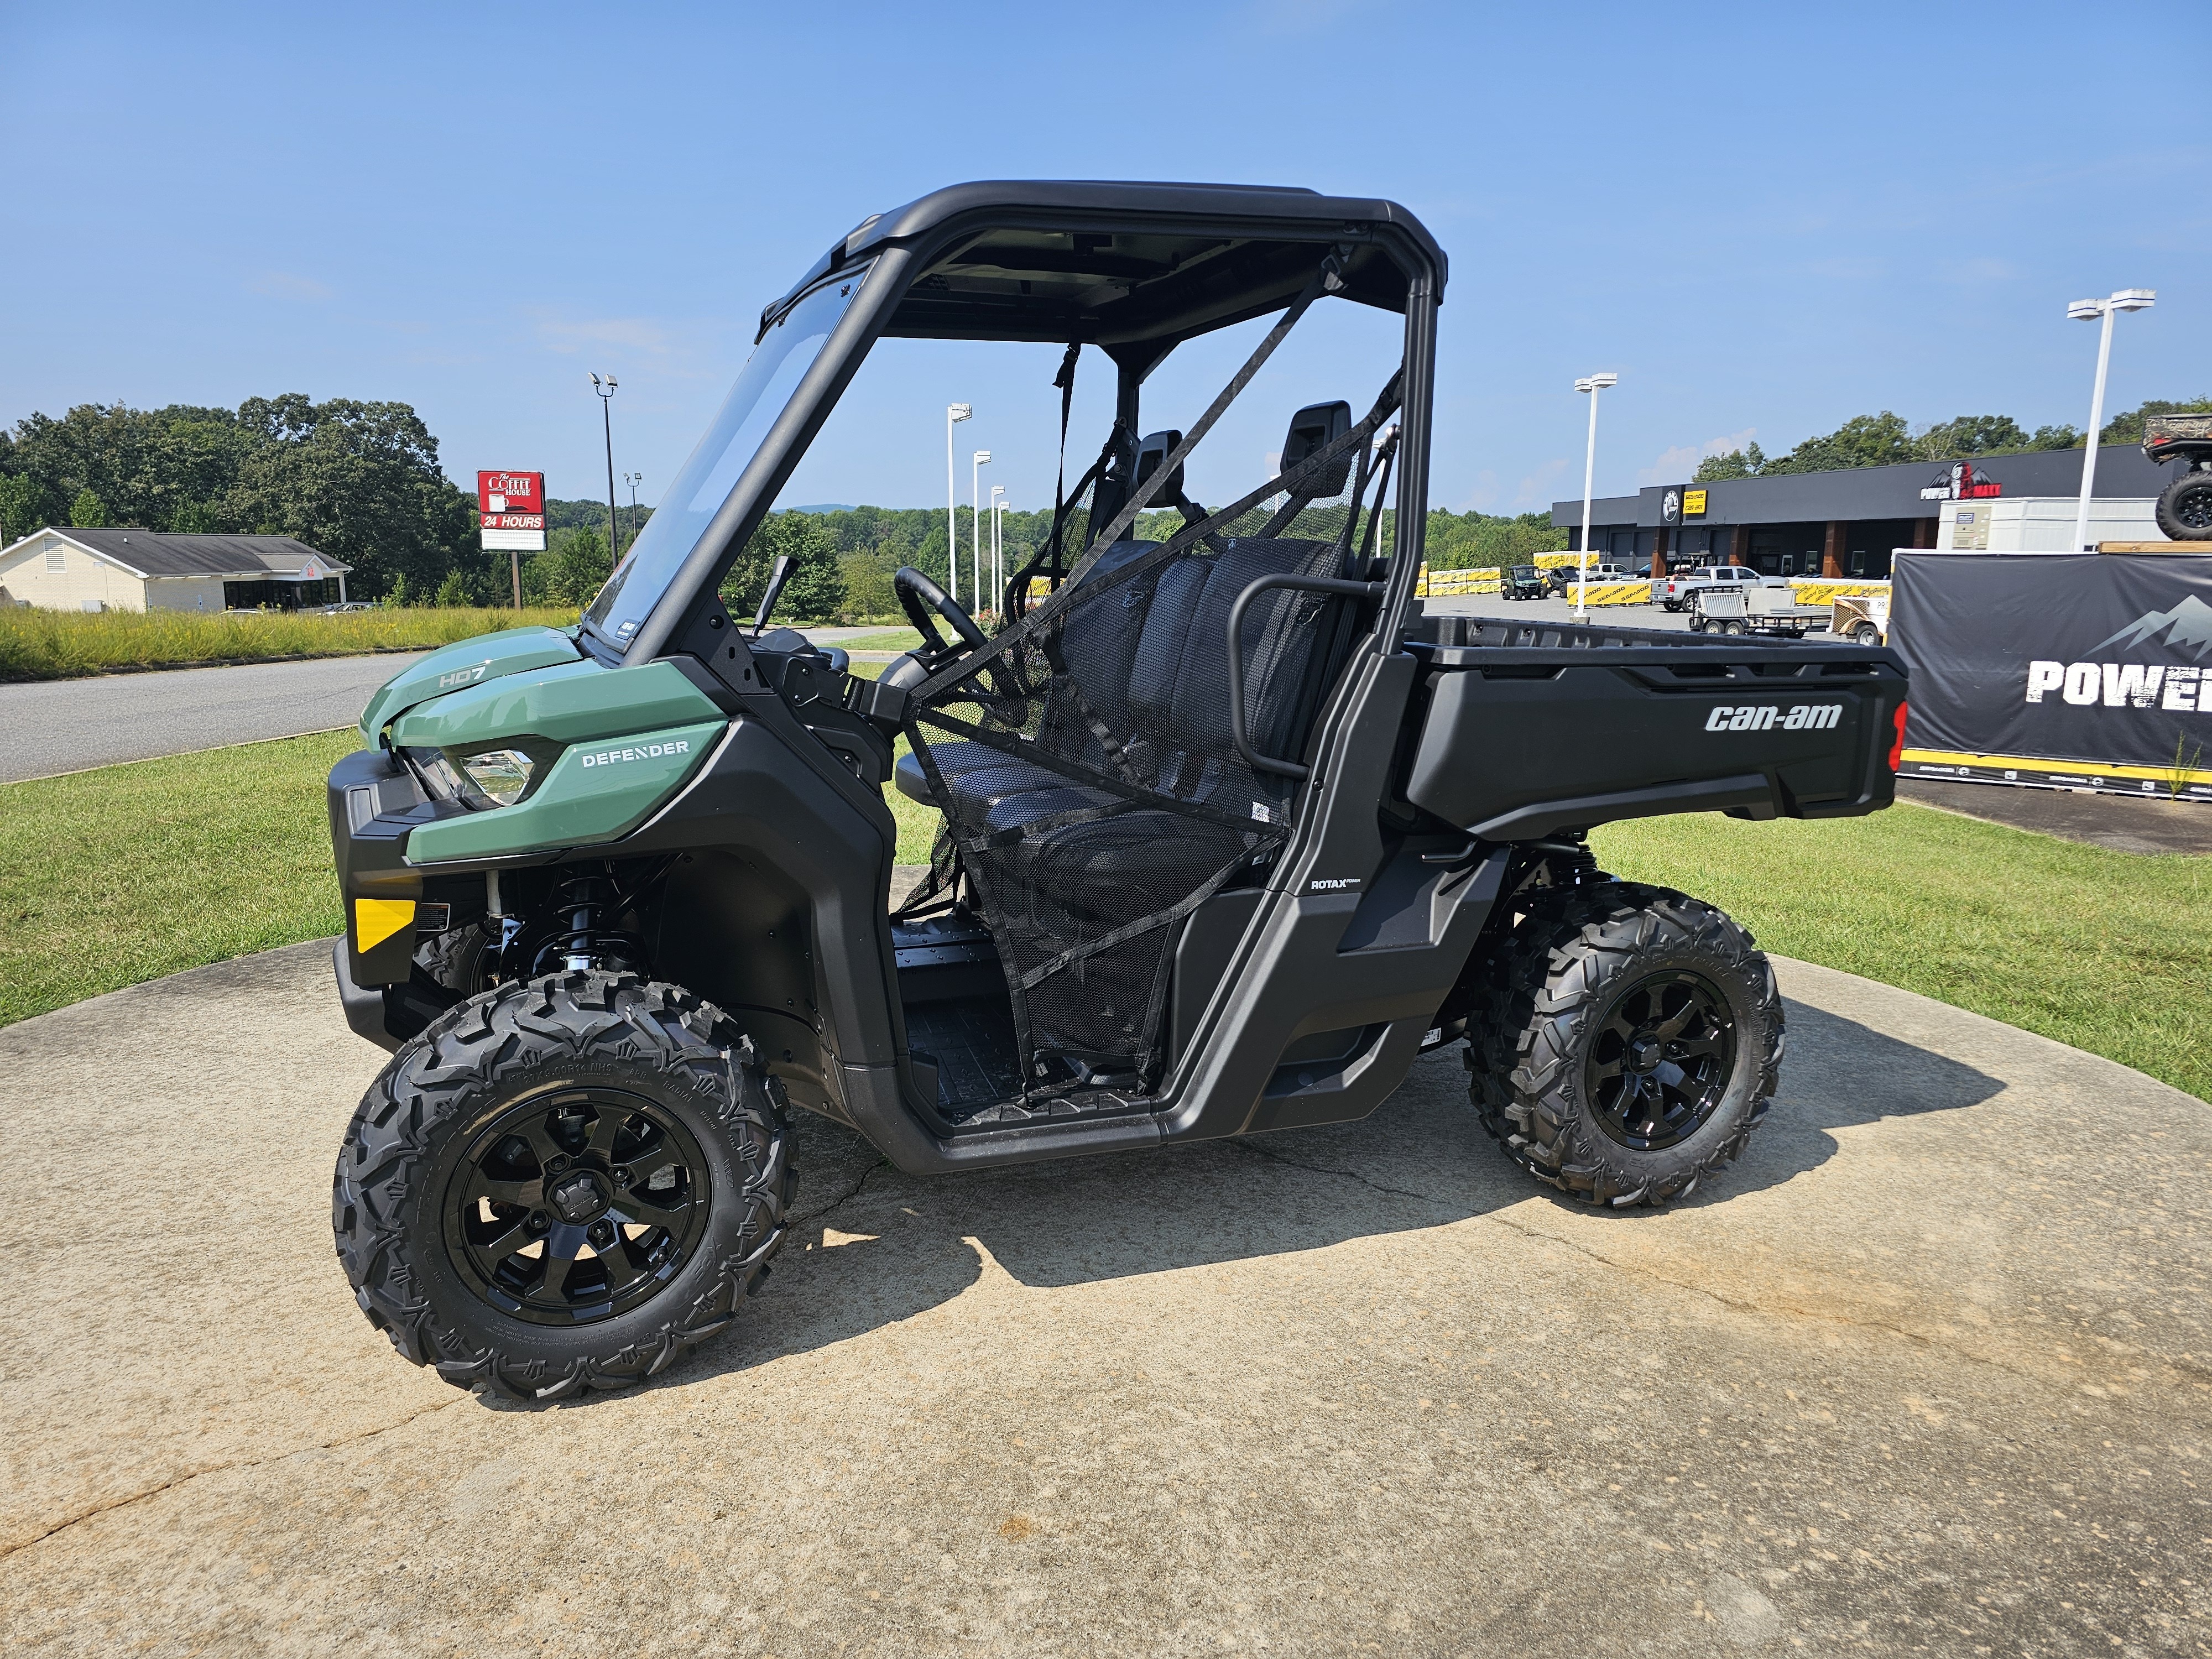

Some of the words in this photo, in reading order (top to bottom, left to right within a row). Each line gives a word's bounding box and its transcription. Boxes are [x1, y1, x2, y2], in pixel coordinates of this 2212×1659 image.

[1920, 487, 1950, 500] POWER
[1973, 483, 2002, 497] MAXX
[484, 516, 497, 526] 24
[502, 516, 541, 528] HOURS
[439, 666, 486, 687] HD7
[1705, 704, 1843, 731] can-am
[582, 740, 689, 768] DEFENDER
[1311, 879, 1347, 890] ROTAX
[590, 1062, 613, 1071] NHS
